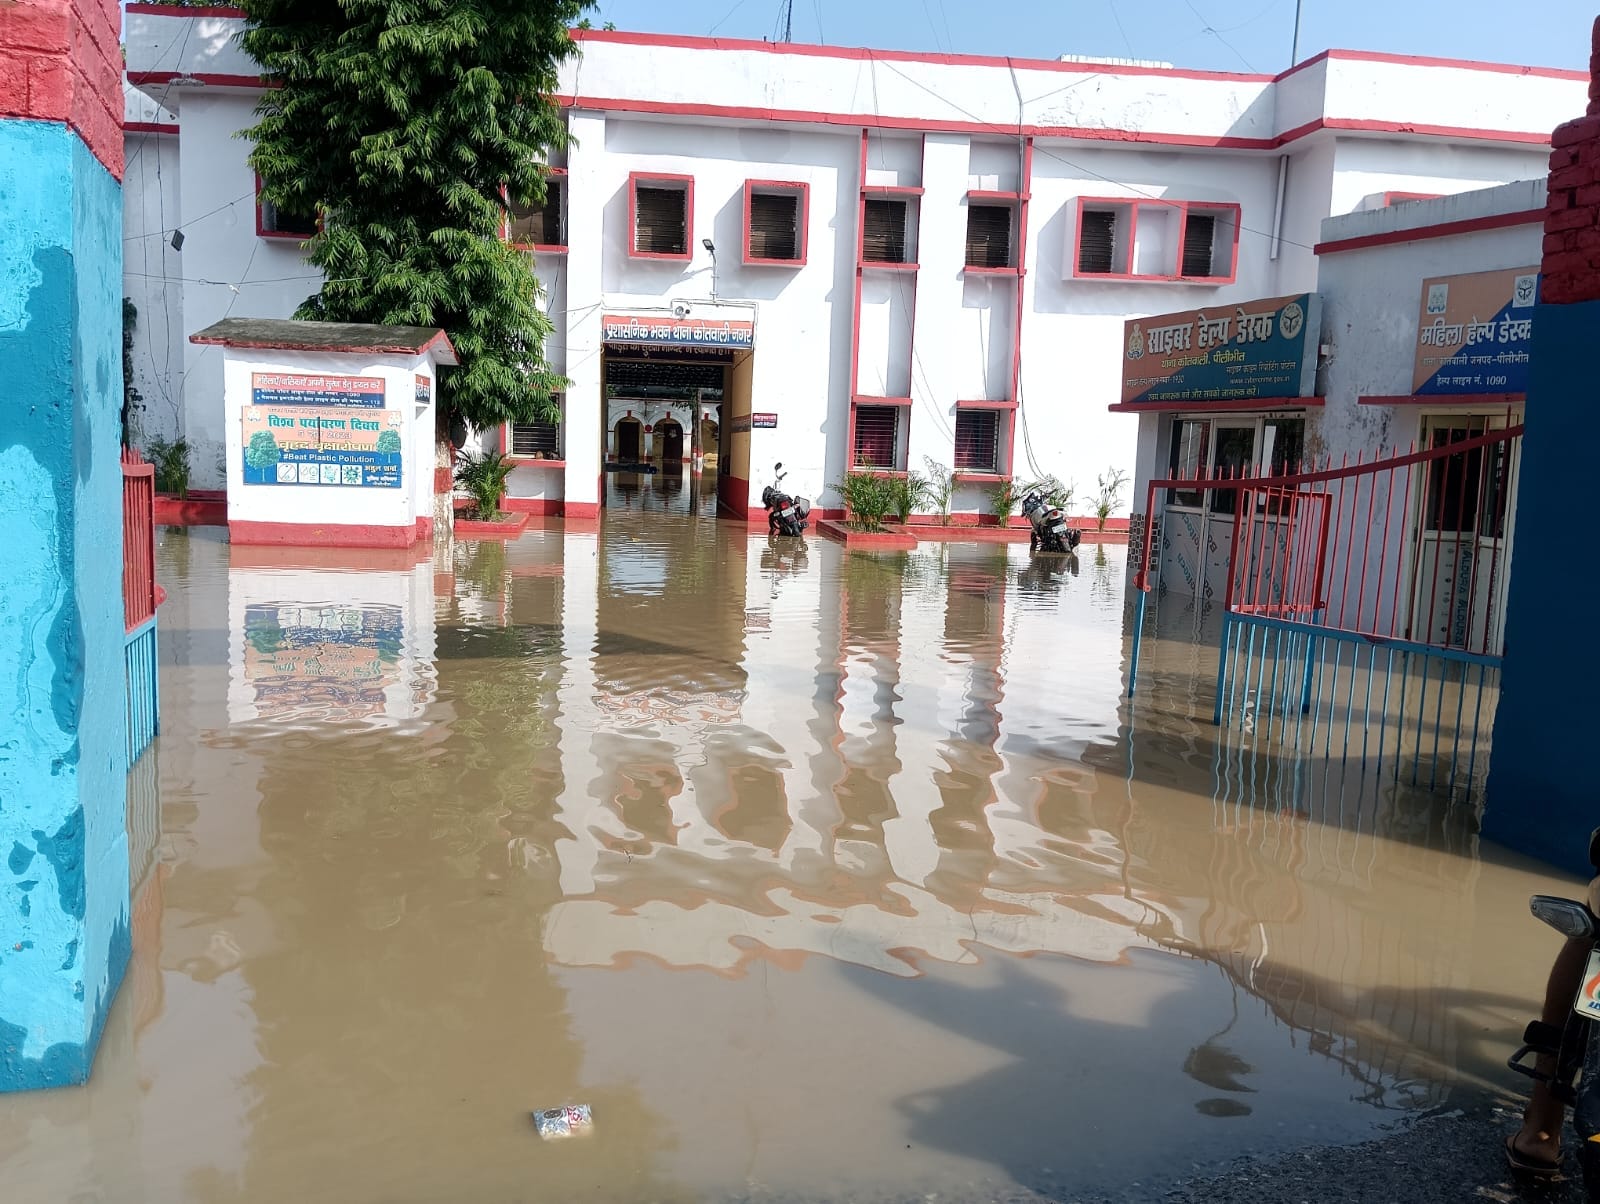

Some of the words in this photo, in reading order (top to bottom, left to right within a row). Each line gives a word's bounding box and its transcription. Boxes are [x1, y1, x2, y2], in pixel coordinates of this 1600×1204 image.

[606, 318, 649, 340] प्रशासनिक
[650, 325, 671, 340] भवन
[672, 325, 691, 340] थाना
[693, 322, 730, 342] कोतवाली
[731, 328, 752, 342] नगर
[1147, 322, 1194, 357] साइबर
[1198, 313, 1232, 347] हेल्प
[1236, 307, 1276, 344] डेस्क
[1421, 317, 1464, 347] महिला
[1466, 314, 1497, 346] हेल्प
[1498, 312, 1532, 343] डेस्क
[1161, 357, 1177, 369] थाना
[1213, 349, 1245, 363] पीलीभीत
[1436, 374, 1450, 387] हेल्प
[1452, 376, 1472, 386] लाइन
[1486, 375, 1507, 386] 1090
[267, 414, 295, 428] विश्व
[350, 416, 380, 431] दिवस
[309, 453, 336, 462] Plastic
[338, 455, 375, 463] Pollution
